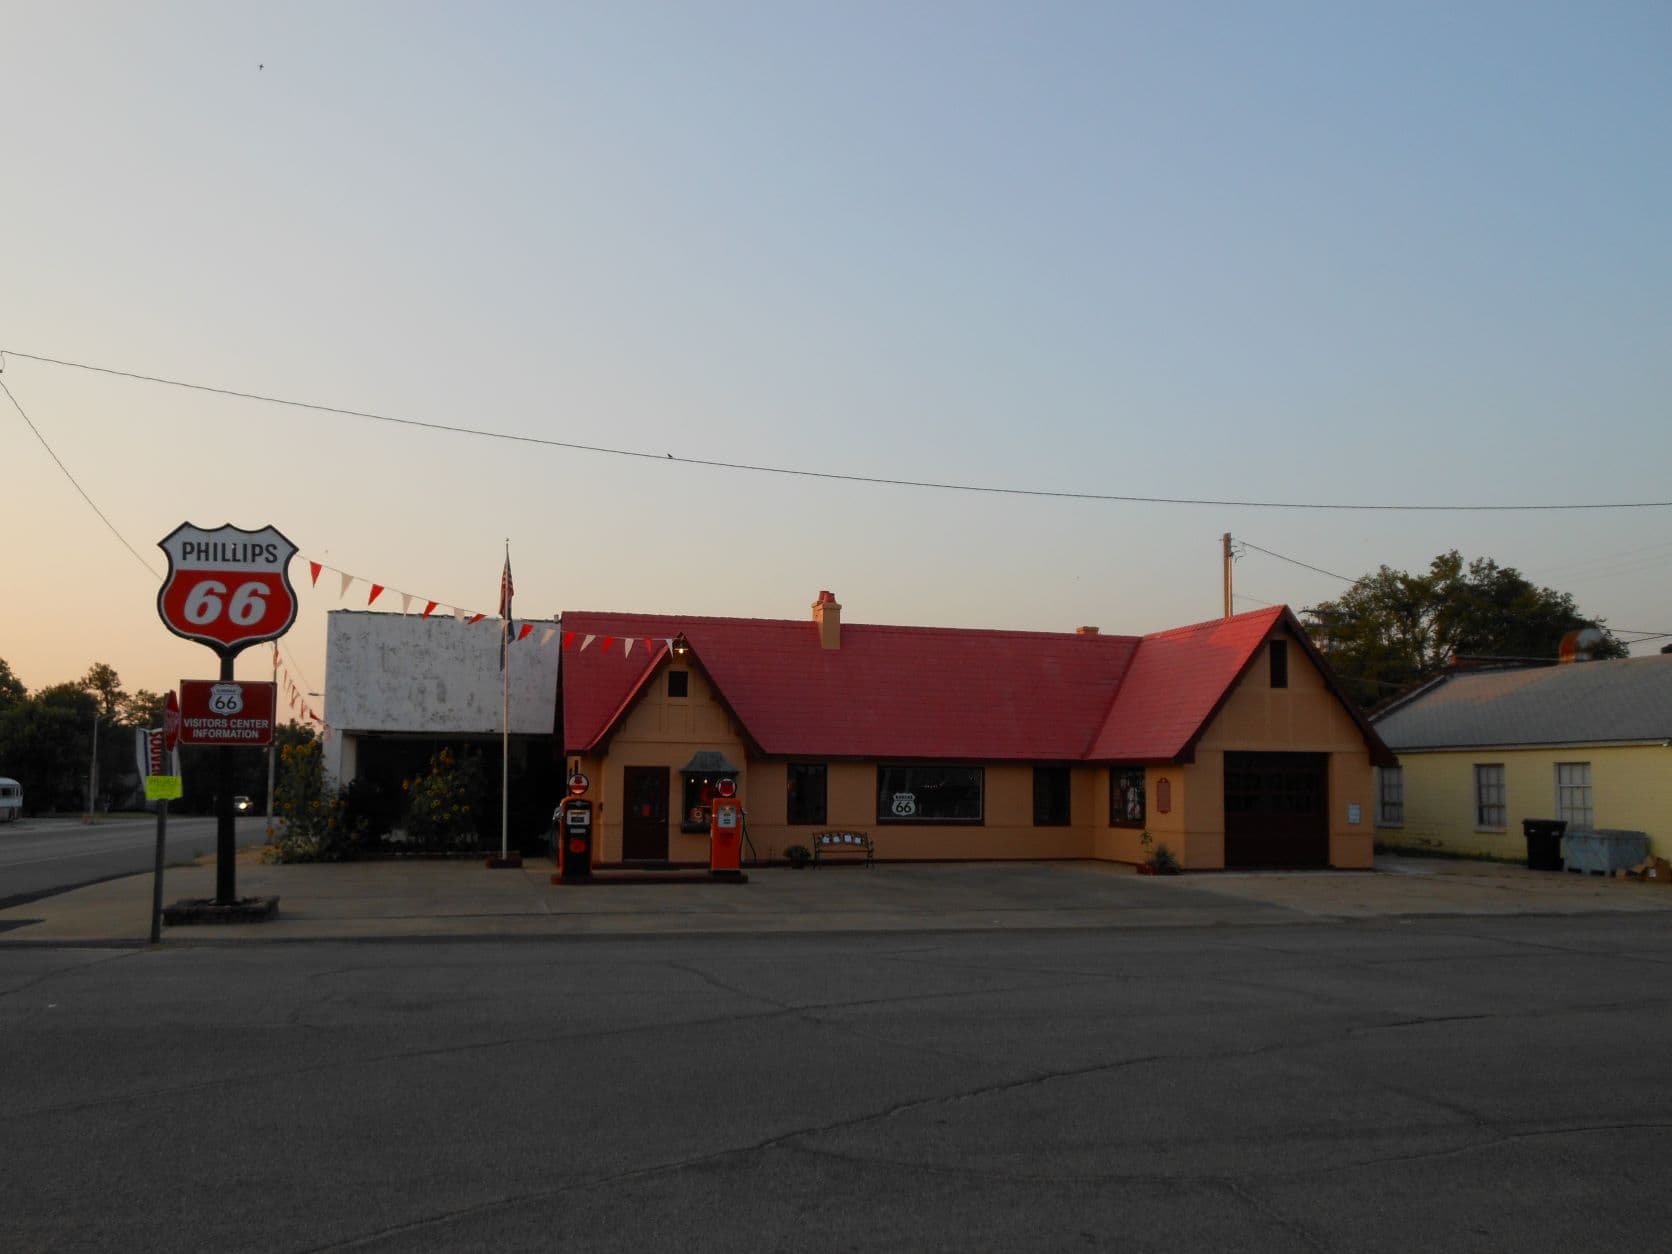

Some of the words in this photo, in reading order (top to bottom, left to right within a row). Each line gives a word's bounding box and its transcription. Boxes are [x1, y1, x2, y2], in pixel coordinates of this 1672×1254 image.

[182, 541, 278, 563] PHILLIPS
[184, 580, 271, 626] 66
[215, 695, 237, 710] 66
[184, 718, 228, 728] VISITORS
[230, 719, 269, 729] CENTER
[193, 729, 259, 739] INFORMATION
[896, 802, 912, 813] 66
